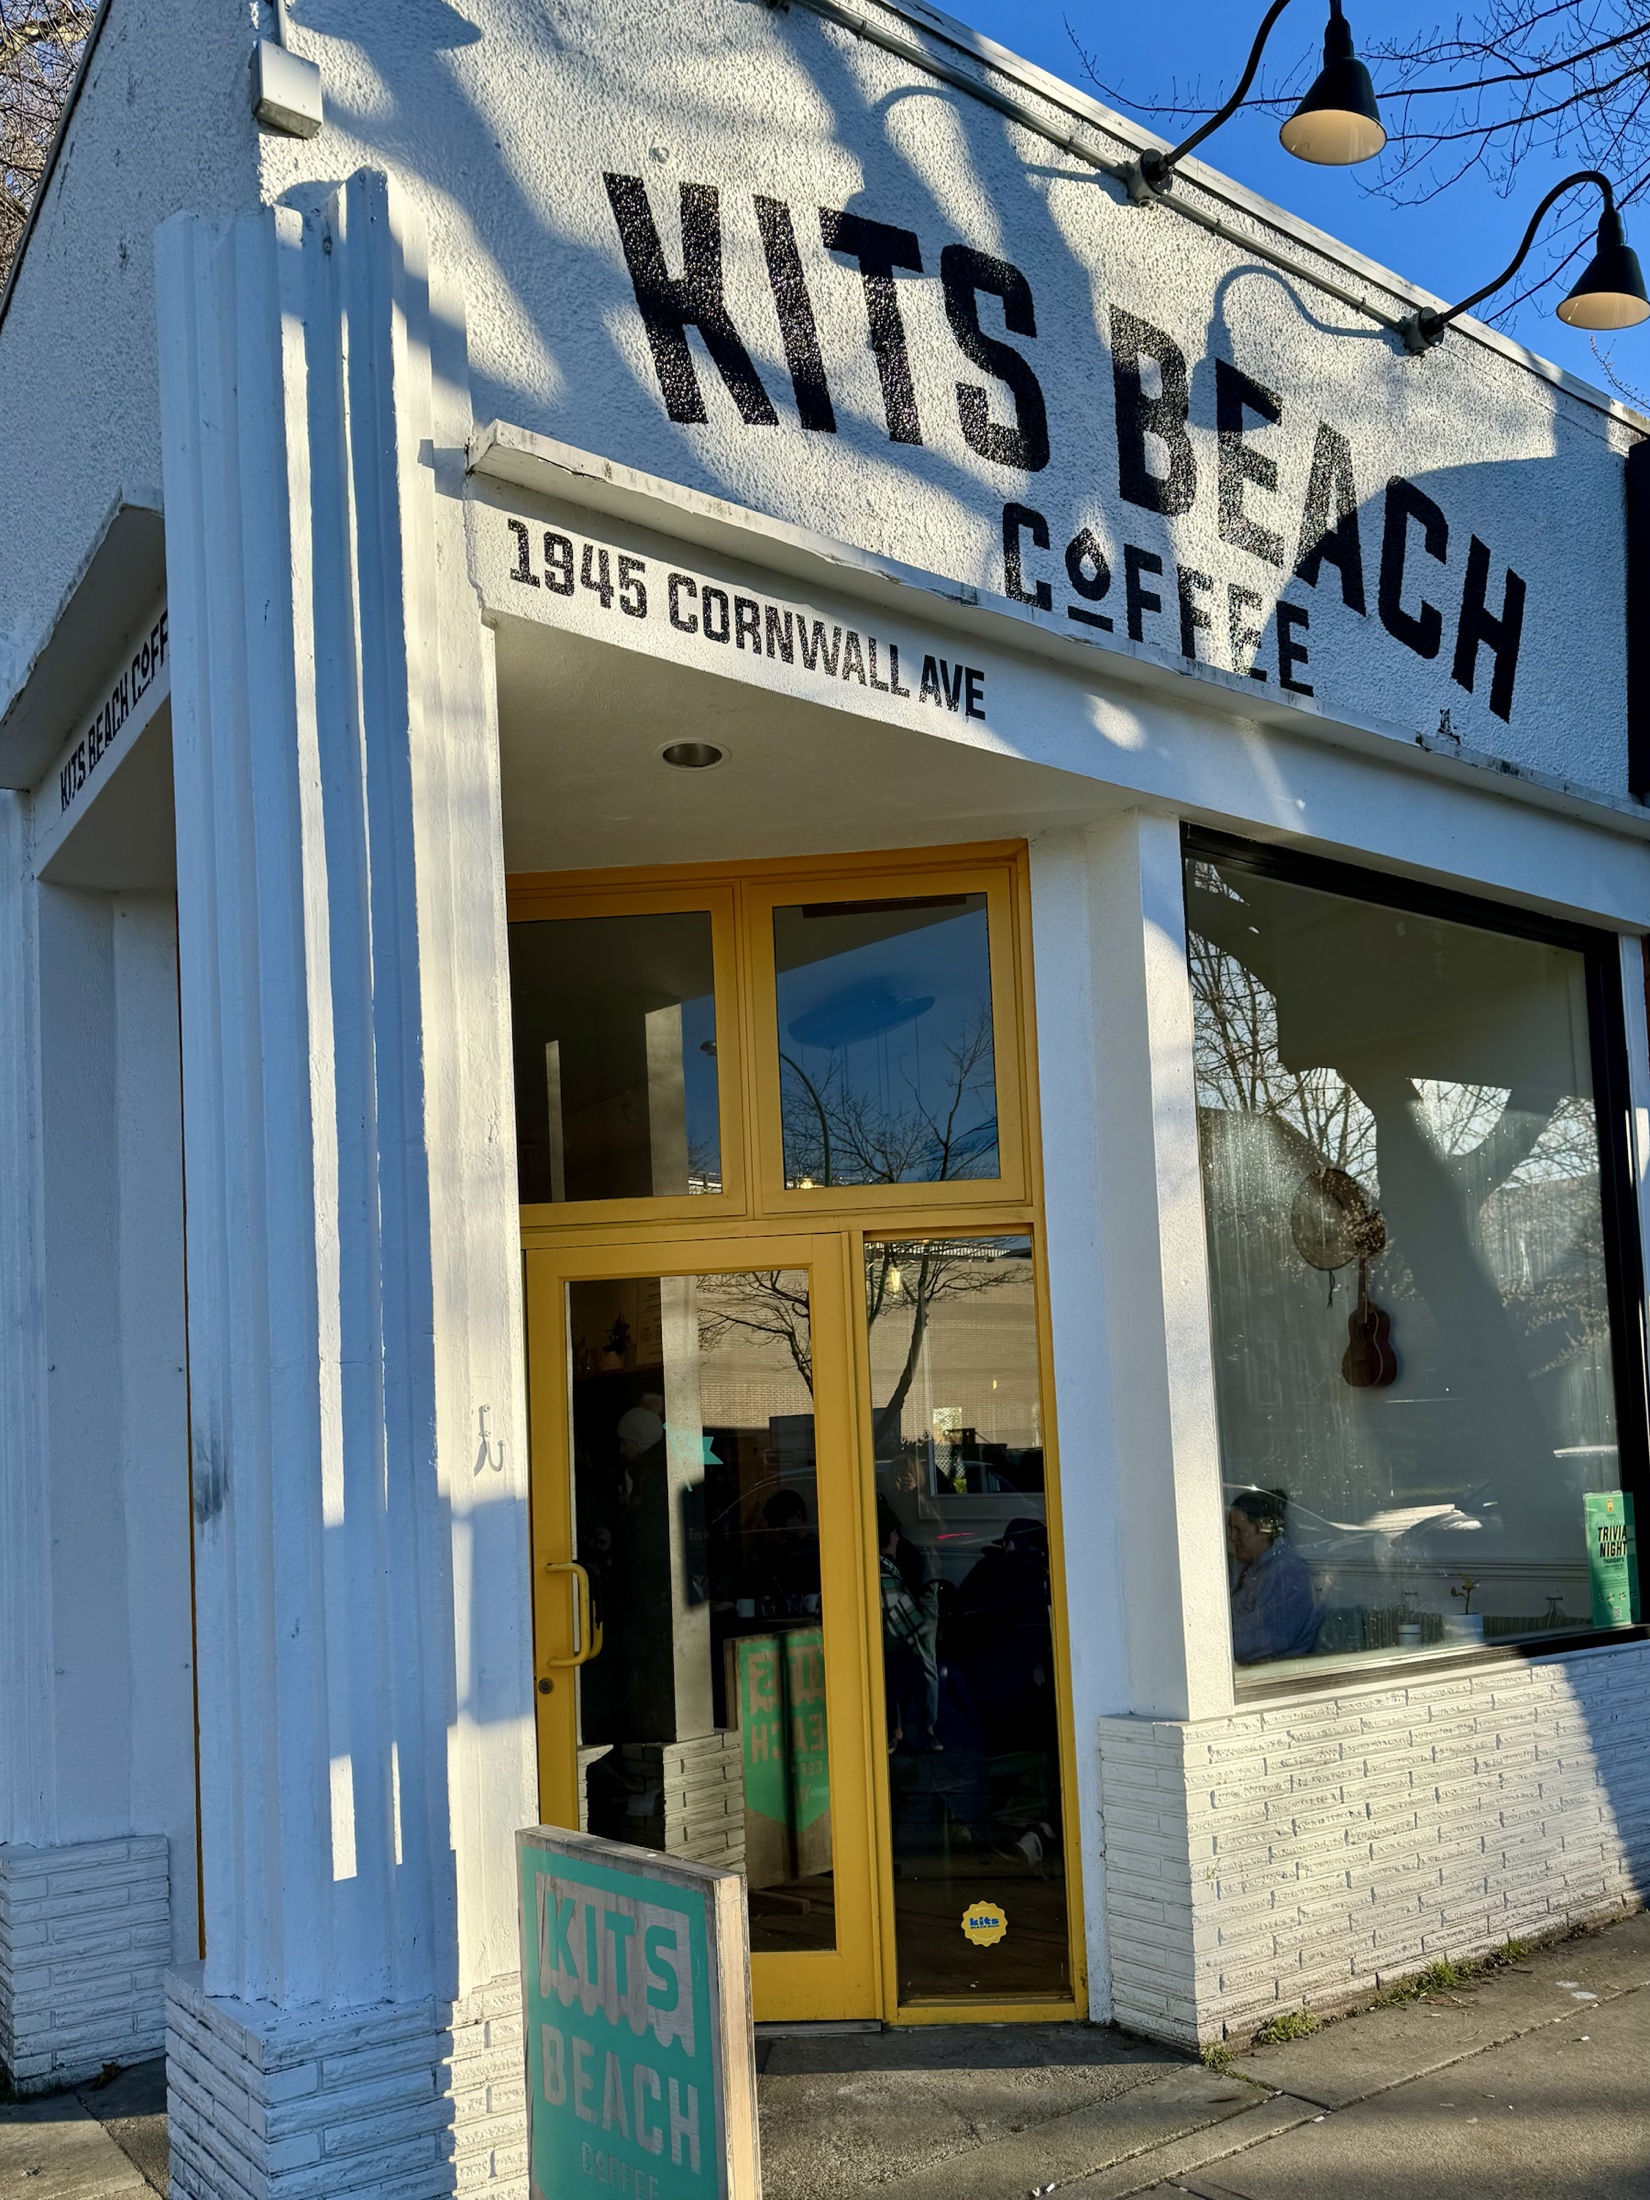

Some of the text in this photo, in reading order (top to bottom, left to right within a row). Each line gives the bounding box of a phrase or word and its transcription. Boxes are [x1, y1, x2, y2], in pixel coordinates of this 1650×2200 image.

[603, 171, 1526, 724] KITS BEACH
[507, 518, 987, 721] 1945 CORNWALL AVE
[1002, 502, 1315, 698] COFFEE
[60, 609, 169, 813] KITS BEACH COFF
[1598, 1525, 1628, 1542] TRIVIA
[1600, 1541, 1628, 1558] NIGHT
[546, 1891, 679, 2012] KITS
[541, 2022, 701, 2176] BEACH
